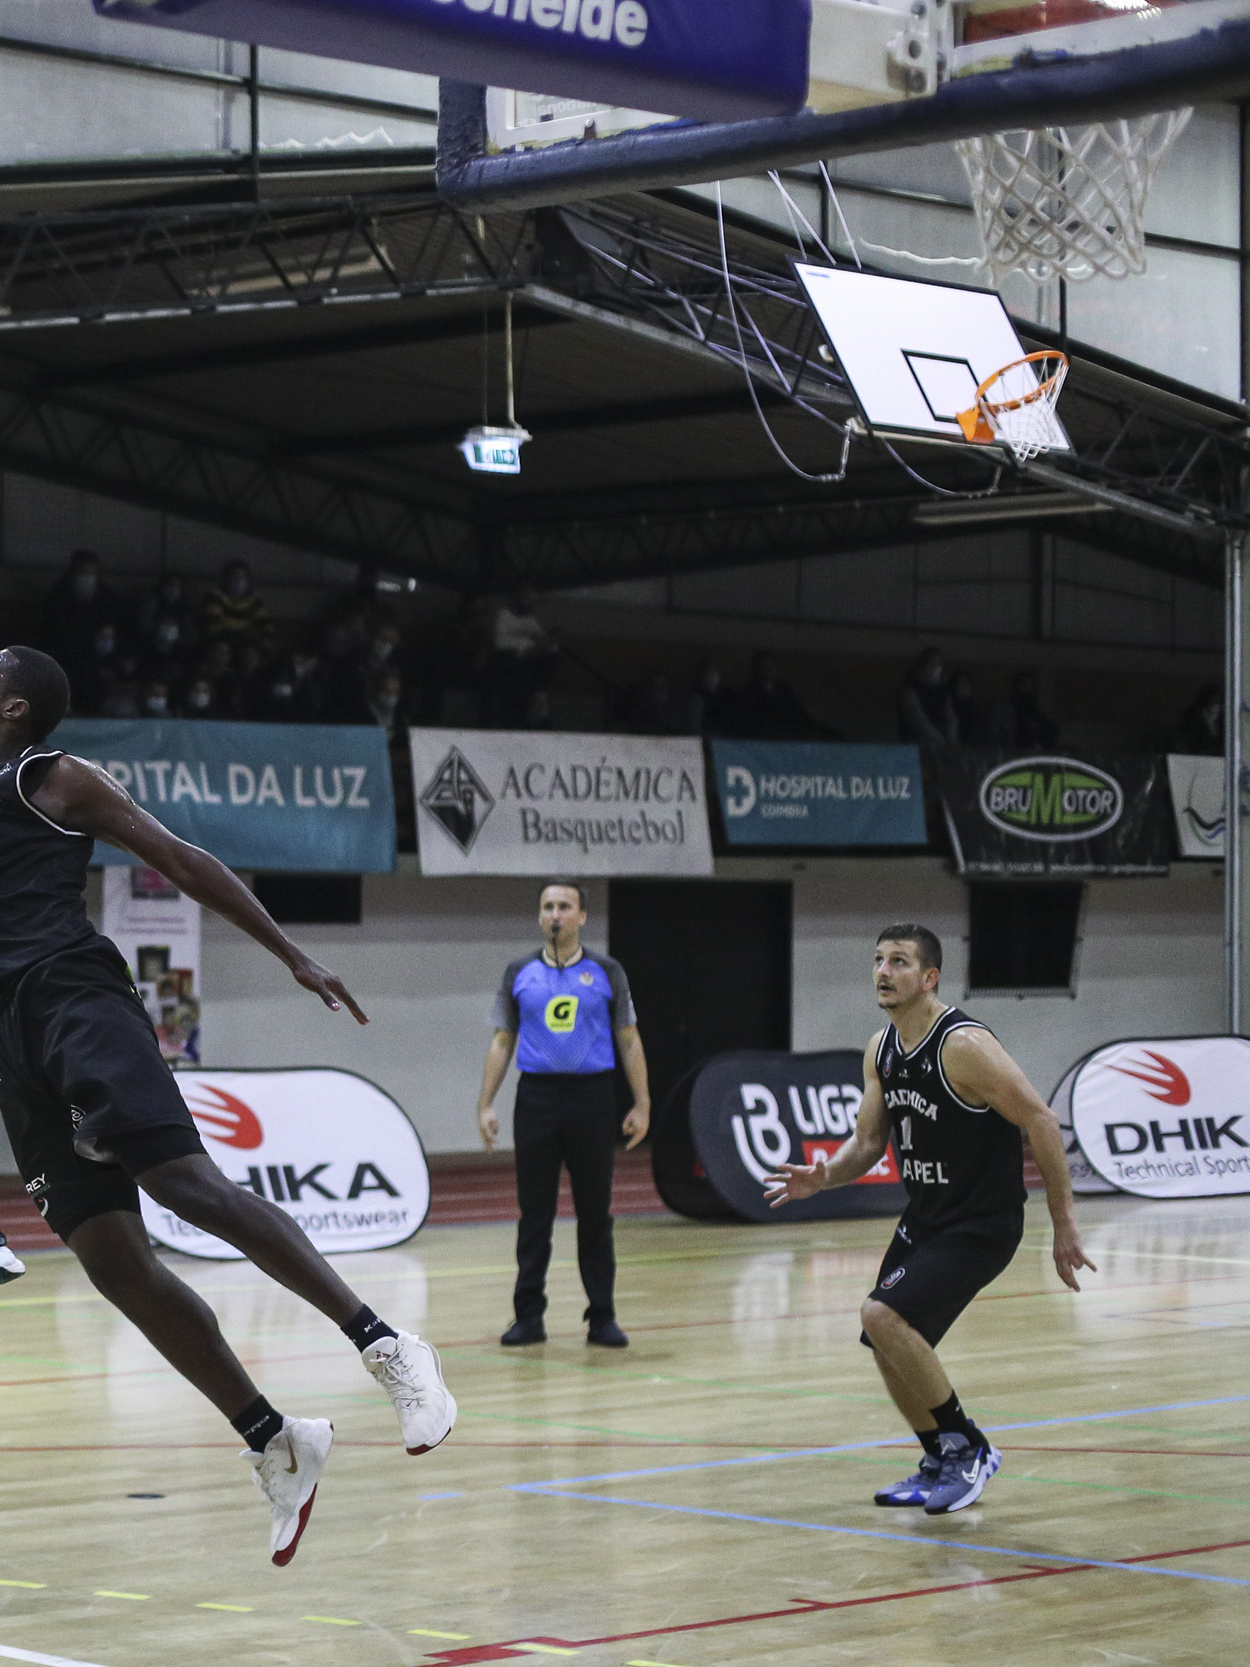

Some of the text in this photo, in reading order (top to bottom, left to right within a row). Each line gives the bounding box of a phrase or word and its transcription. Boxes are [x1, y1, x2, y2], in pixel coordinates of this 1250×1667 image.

[102, 761, 371, 808] PITAL DA LUZ
[502, 755, 698, 804] ACADÉMICA
[759, 774, 911, 800] HOSPITAL DA LUZ
[990, 772, 1115, 825] BRUMOTOR
[519, 806, 686, 855] Basquetebol
[553, 1001, 571, 1020] G
[900, 1116, 913, 1151] 1
[1104, 1114, 1250, 1157] DHIK
[234, 1162, 401, 1202] HIKA
[902, 1158, 949, 1184] APEL
[1112, 1155, 1202, 1181] Technical
[1203, 1153, 1250, 1179] Sport
[296, 1208, 409, 1235] portswear
